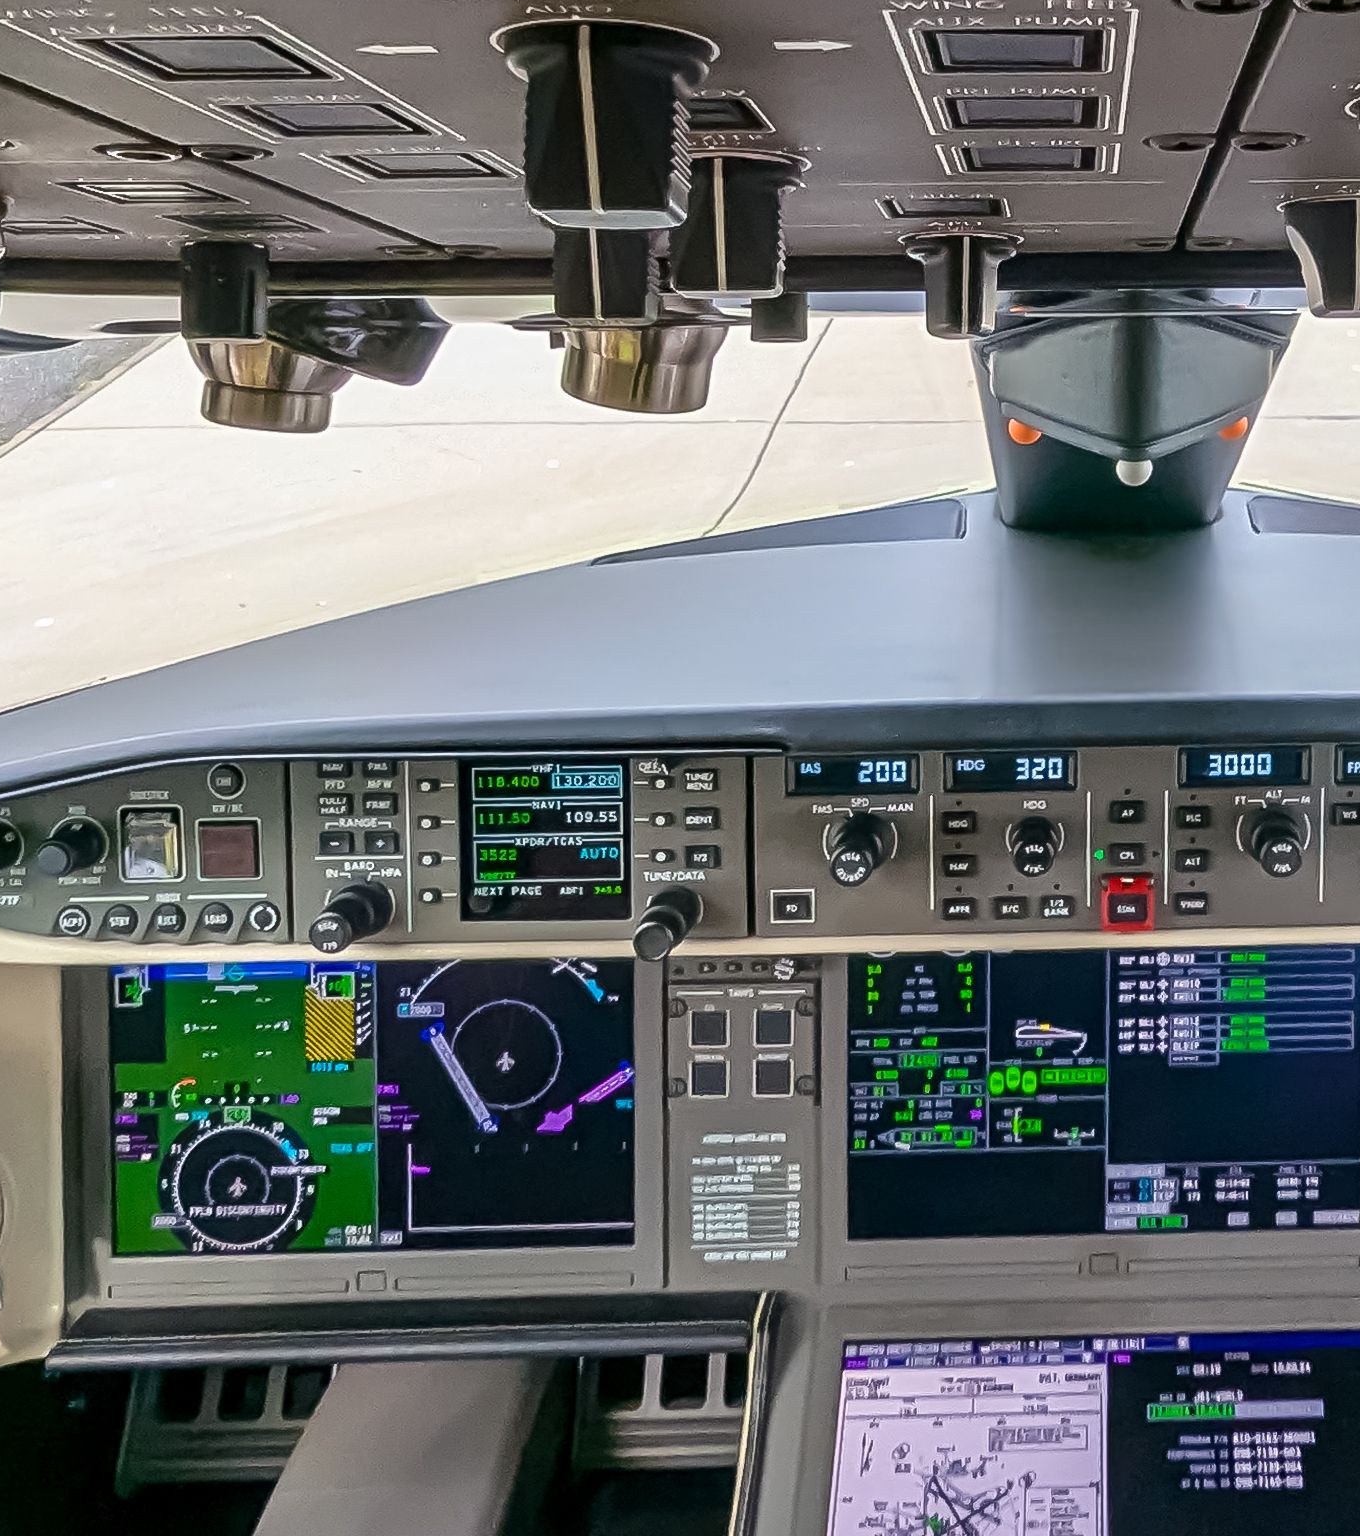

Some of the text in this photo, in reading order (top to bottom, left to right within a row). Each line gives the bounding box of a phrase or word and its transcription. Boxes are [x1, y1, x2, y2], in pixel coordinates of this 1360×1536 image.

[911, 14, 1118, 27] AUX PUMP
[800, 759, 908, 783] IAS 200
[956, 756, 1064, 781] HDG 320
[1207, 752, 1273, 778] 3000
[478, 774, 618, 789] 118.400 130.200
[1233, 794, 1248, 806] FT
[1264, 788, 1284, 800] ALT
[850, 797, 871, 808] SPD
[886, 802, 915, 813] MAN
[1022, 799, 1048, 811] HDG
[478, 810, 618, 825] 111.50 109.55
[1120, 808, 1136, 819] AP
[338, 817, 378, 828] RANGE
[513, 836, 584, 847] XPDR/TCAS
[479, 846, 620, 862] 3522 AUTO
[343, 860, 376, 872] BARO
[642, 870, 707, 882] TUNE/DATA
[473, 885, 505, 896] NEXT
[510, 885, 543, 896] PAGE
